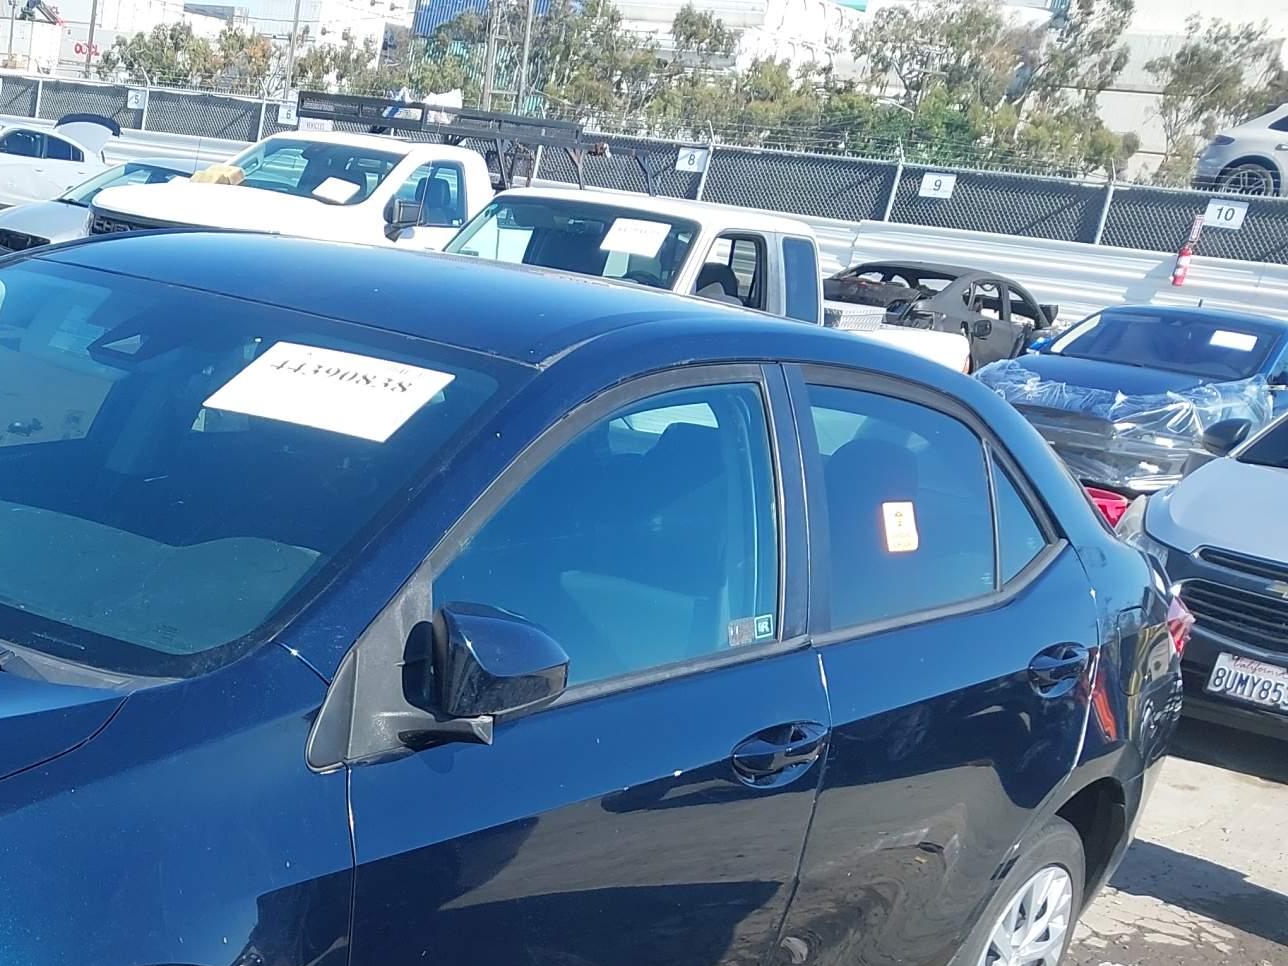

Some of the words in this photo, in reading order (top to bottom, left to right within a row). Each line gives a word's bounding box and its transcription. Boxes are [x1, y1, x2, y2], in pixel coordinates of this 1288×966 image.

[134, 95, 140, 104] 5
[286, 110, 291, 119] 6
[688, 155, 695, 165] 8
[933, 179, 942, 191] 9
[1216, 206, 1236, 221] 10
[1213, 667, 1288, 704] 8UMY85
